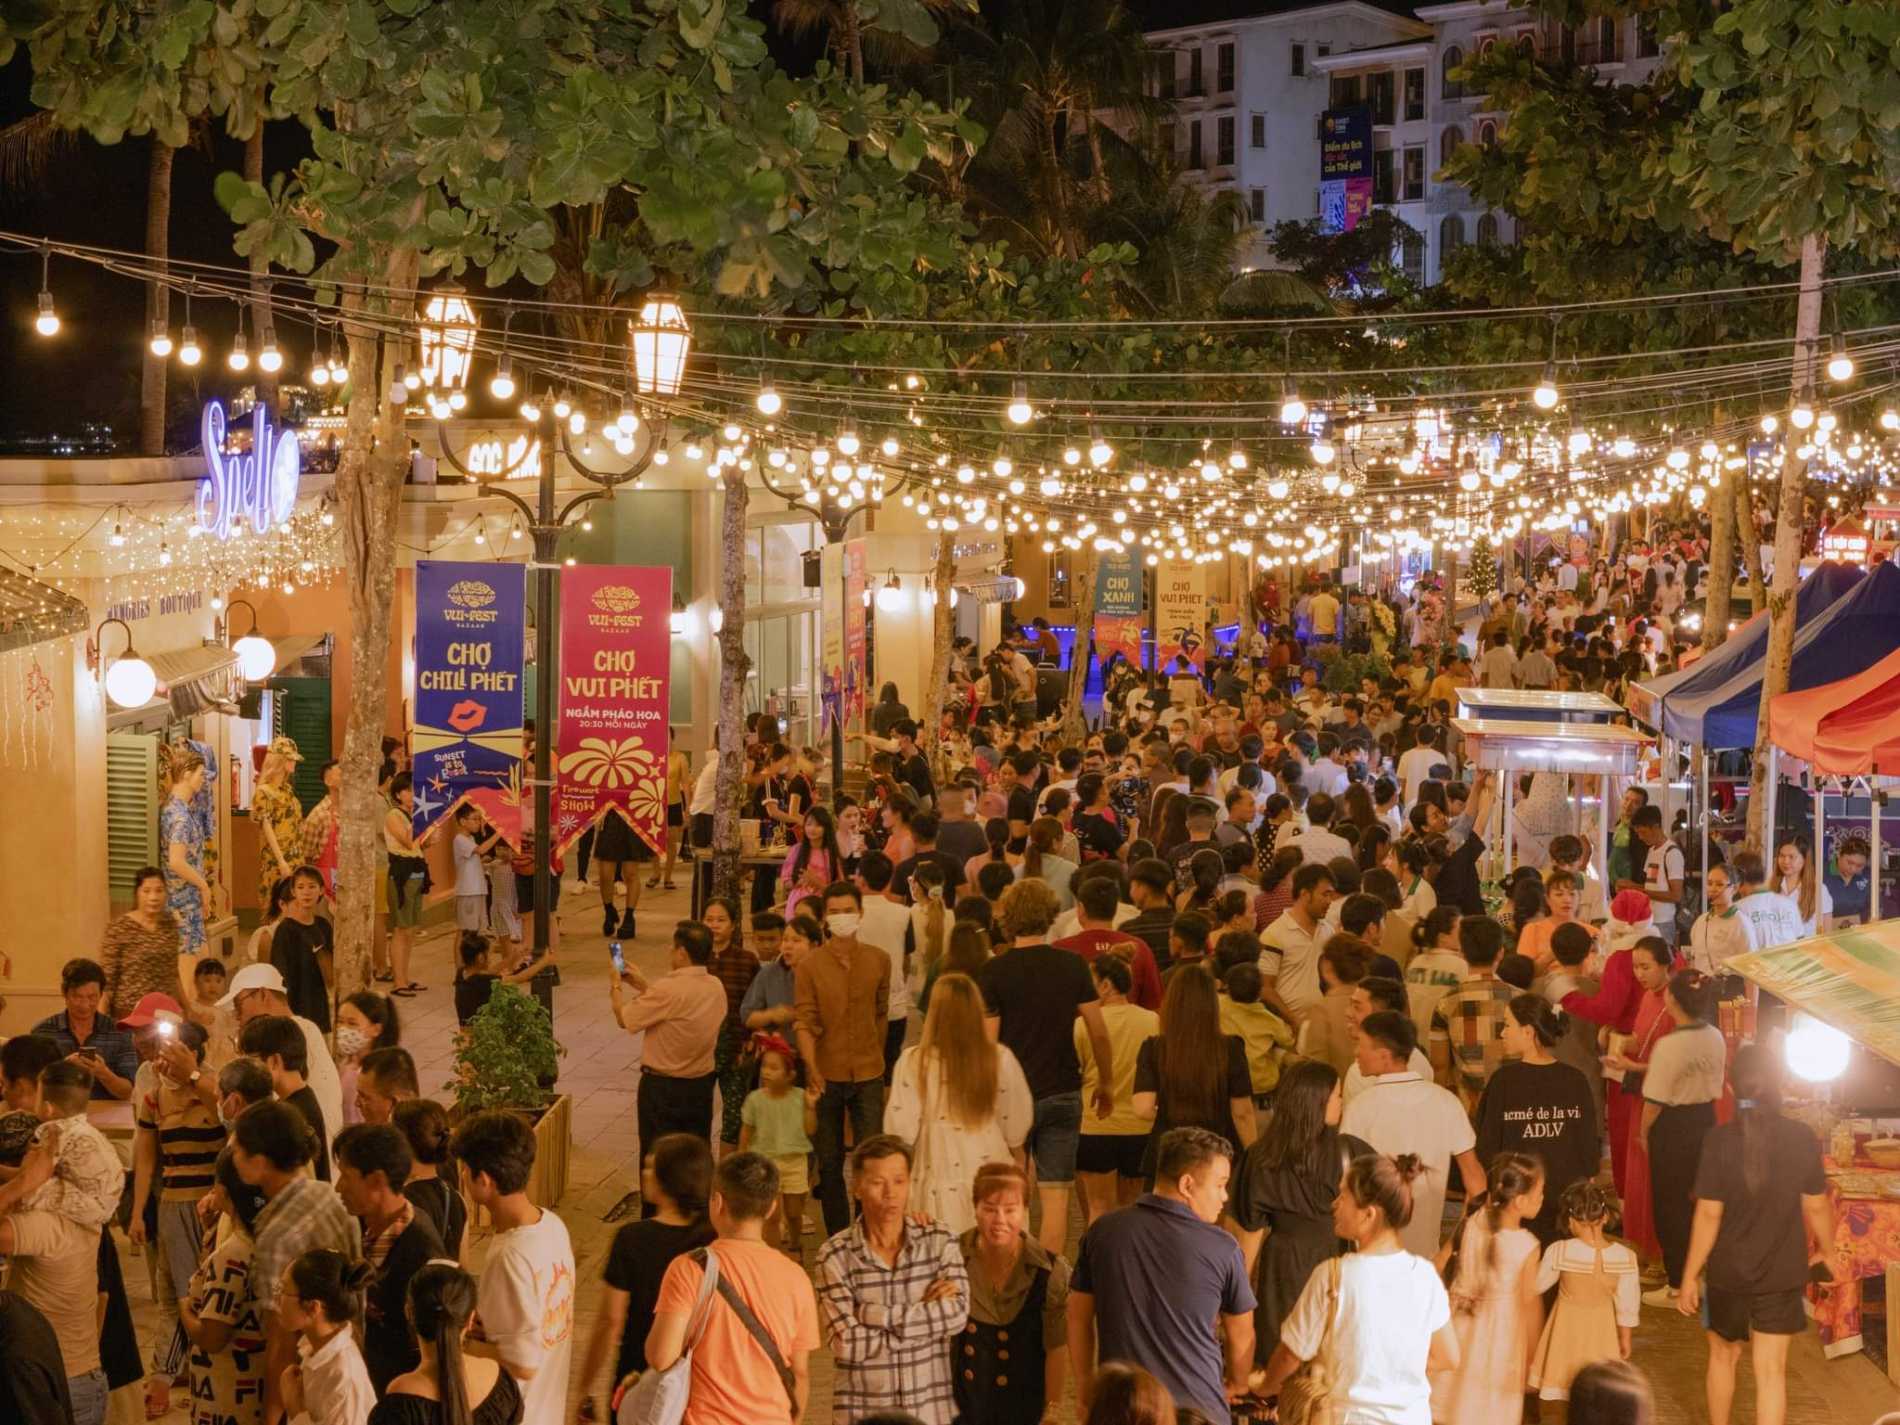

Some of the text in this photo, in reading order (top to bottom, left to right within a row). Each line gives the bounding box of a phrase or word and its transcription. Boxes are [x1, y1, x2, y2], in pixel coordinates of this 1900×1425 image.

[160, 591, 202, 617] BOUTIQUE
[1103, 592, 1135, 603] XANH
[447, 642, 491, 670] CHỢ
[594, 650, 635, 676] CHỢ
[470, 670, 518, 691] PHẾT
[567, 676, 662, 699] VUI PHẾT
[602, 708, 634, 719] PHÁO
[636, 711, 661, 720] HOA
[560, 800, 595, 812] SHOW
[1536, 1107, 1549, 1120] de
[1553, 1106, 1564, 1119] la
[1567, 1105, 1581, 1119] vi
[1522, 1122, 1564, 1138] ADLV
